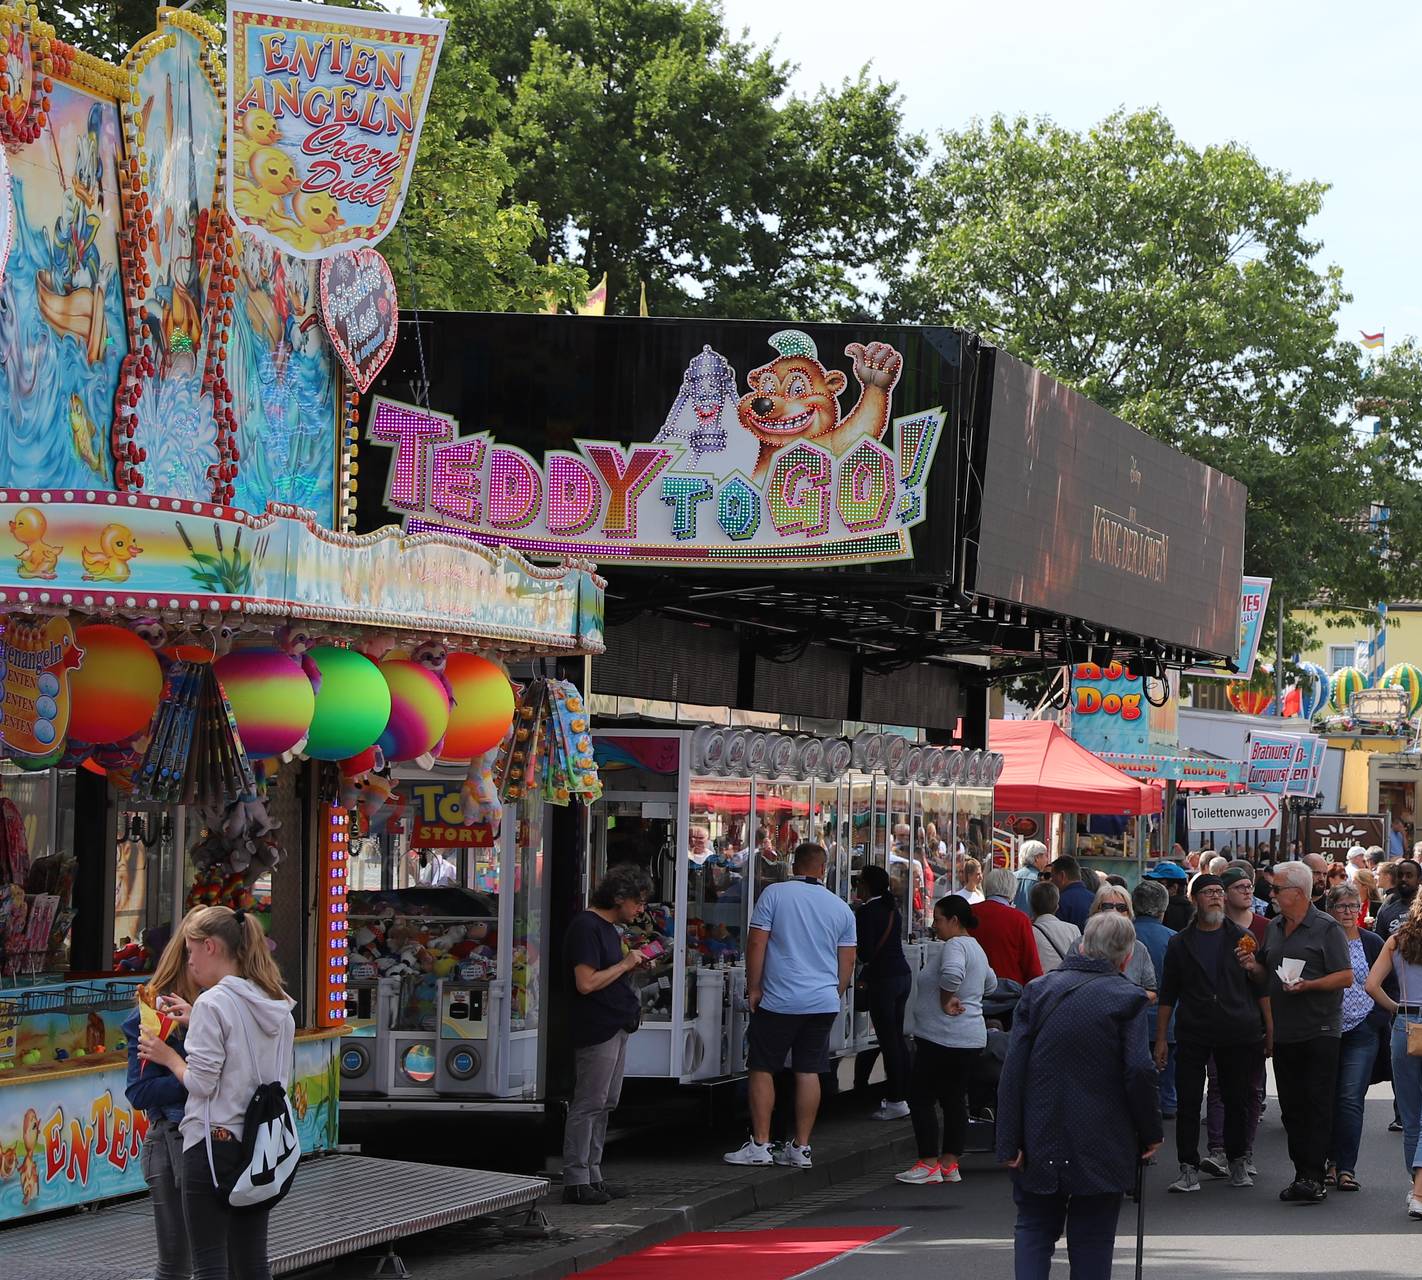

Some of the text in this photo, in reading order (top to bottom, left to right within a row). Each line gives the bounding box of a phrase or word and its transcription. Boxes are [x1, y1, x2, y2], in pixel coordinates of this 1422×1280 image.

[260, 32, 404, 90] ENTEN
[238, 77, 412, 134] ANGELN
[301, 123, 401, 179] Crazy
[300, 160, 393, 206] Duck
[373, 402, 938, 541] TEDDY TO GO!
[8, 669, 36, 689] ENTEN
[6, 692, 35, 711] ENTEN
[1076, 687, 1141, 720] Dog
[1251, 742, 1292, 761] Bratwurst
[1184, 764, 1227, 779] Hot-Dog
[1248, 766, 1290, 787] Currywurst
[414, 785, 466, 824] TO
[1191, 807, 1270, 820] Toilettenwagen
[420, 827, 487, 842] STORY
[1320, 836, 1361, 849] Hardt's
[43, 1089, 150, 1187] ENTEN
